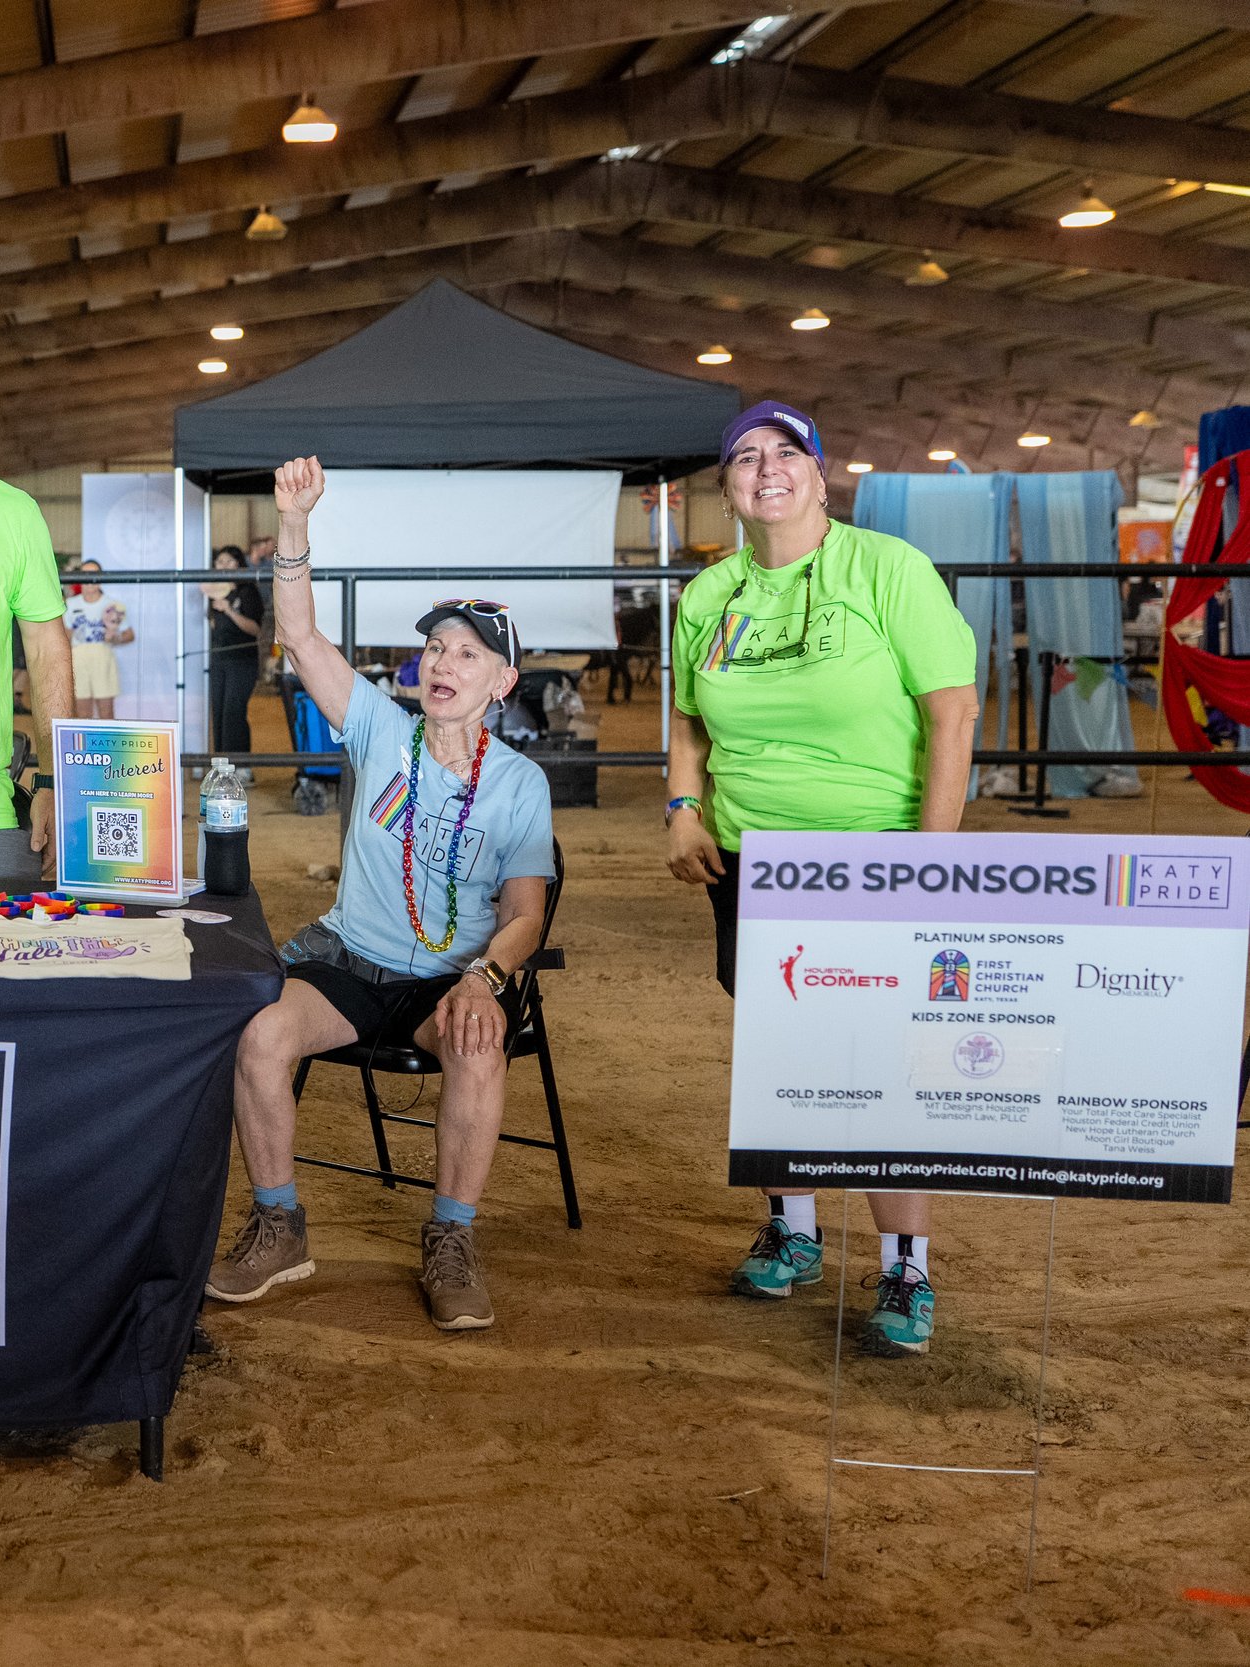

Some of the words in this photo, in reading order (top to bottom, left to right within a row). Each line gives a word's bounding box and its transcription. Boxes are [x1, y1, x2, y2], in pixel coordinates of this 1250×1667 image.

[748, 610, 836, 643] KAY
[741, 634, 833, 662] PRDE
[91, 739, 117, 748] KATY
[121, 740, 153, 749] PRIDE
[65, 752, 112, 766] BOARD
[103, 758, 165, 781] Interest
[1141, 863, 1223, 879] KATY
[751, 860, 851, 892] 2026
[861, 861, 1098, 896] SPONSORS
[1139, 885, 1221, 900] PRIDE
[914, 932, 985, 943] PLATINUM
[989, 933, 1065, 945] SPONSORS
[977, 960, 1012, 970] FIRST
[804, 975, 899, 988] COMETS
[975, 972, 1045, 982] CHRISTIAN
[1076, 963, 1178, 998] Dignity
[975, 984, 1029, 994] CHURCH
[912, 1012, 943, 1022] KIDS
[947, 1012, 985, 1023] ZONE
[988, 1013, 1056, 1025] SPONSOR
[776, 1089, 814, 1099] GOLD
[818, 1089, 883, 1100] SPONSOR
[915, 1090, 962, 1101] SILVER
[966, 1091, 1041, 1104] SPONSORS
[812, 1100, 868, 1109] Healthcare
[925, 1102, 940, 1110] MT
[942, 1102, 983, 1112] Designs
[986, 1104, 1030, 1113] Houston
[1057, 1095, 1127, 1108] RAINBOW
[1131, 1098, 1208, 1111] SPONSORS
[926, 1111, 972, 1120] Swanson
[975, 1113, 998, 1122] Law,
[1000, 1114, 1027, 1123] PLLC
[1061, 1108, 1083, 1116] Your
[1086, 1108, 1108, 1117] Total
[1111, 1109, 1131, 1118] Foot
[1134, 1110, 1155, 1119] Care
[1158, 1111, 1202, 1121] Specialist
[1062, 1117, 1102, 1125] Houston
[1104, 1118, 1139, 1127] Federal
[1141, 1119, 1169, 1128] Credit
[1172, 1120, 1200, 1129] Union
[1066, 1125, 1086, 1133] New
[1089, 1126, 1114, 1136] Hope
[1116, 1127, 1159, 1137] Lutheran
[1161, 1129, 1196, 1138] Church
[1085, 1135, 1111, 1143] Moon
[1113, 1136, 1129, 1144] Girl
[1132, 1136, 1175, 1146] Boutique
[1103, 1144, 1126, 1153] Tana
[1128, 1145, 1155, 1154] Weiss
[788, 1161, 878, 1176] katypride.org
[888, 1162, 1018, 1180] @KatyPrideLGBTQ
[1028, 1168, 1164, 1189] info@katypride.org
